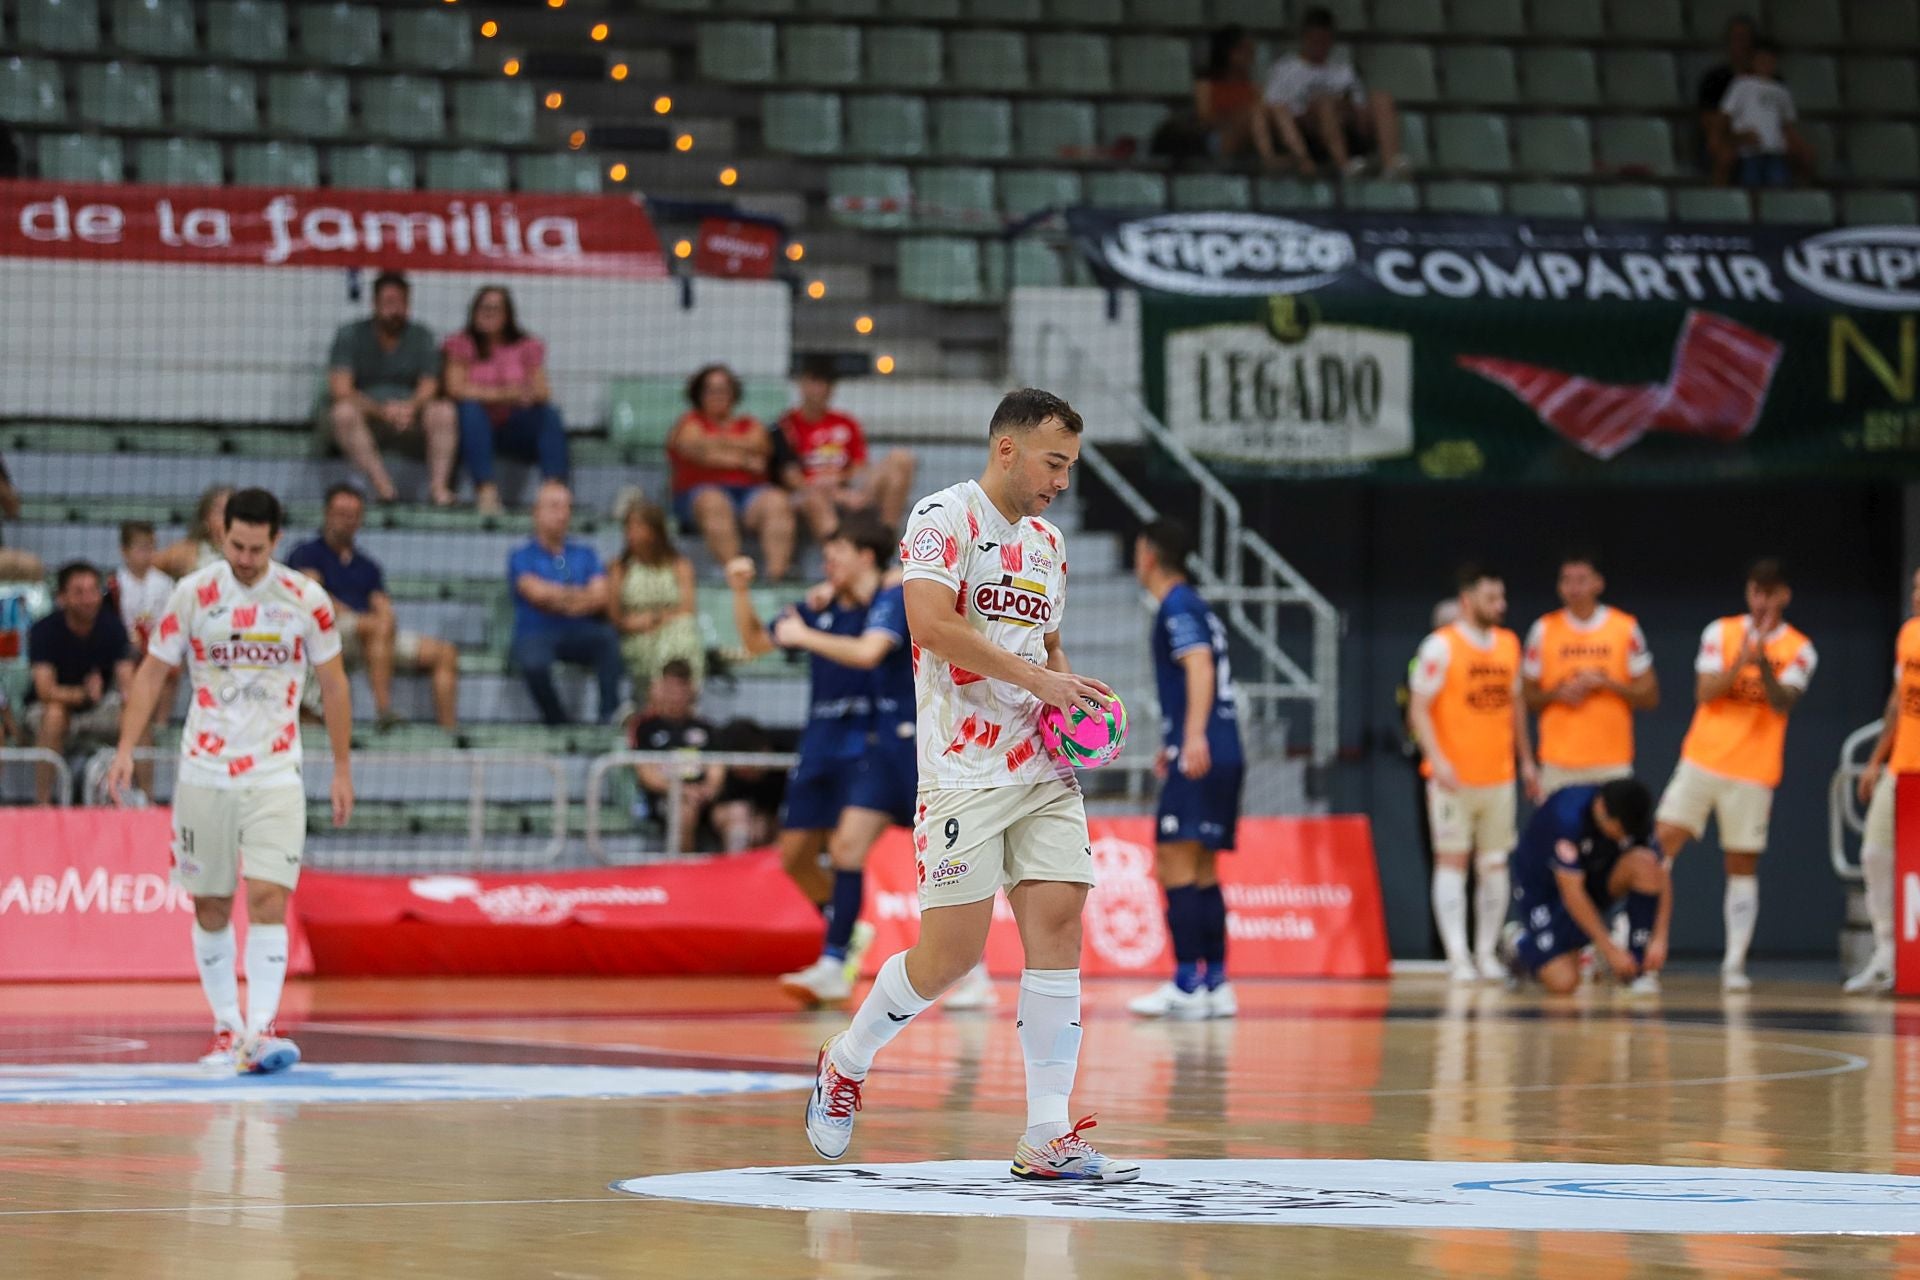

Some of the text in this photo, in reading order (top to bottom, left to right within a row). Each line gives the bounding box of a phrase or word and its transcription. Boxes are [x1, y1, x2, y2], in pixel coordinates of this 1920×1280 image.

[20, 195, 582, 263] de la familia
[1374, 248, 1782, 301] COMPARTIR
[1196, 352, 1381, 425] LEGADO
[944, 817, 960, 850] 9
